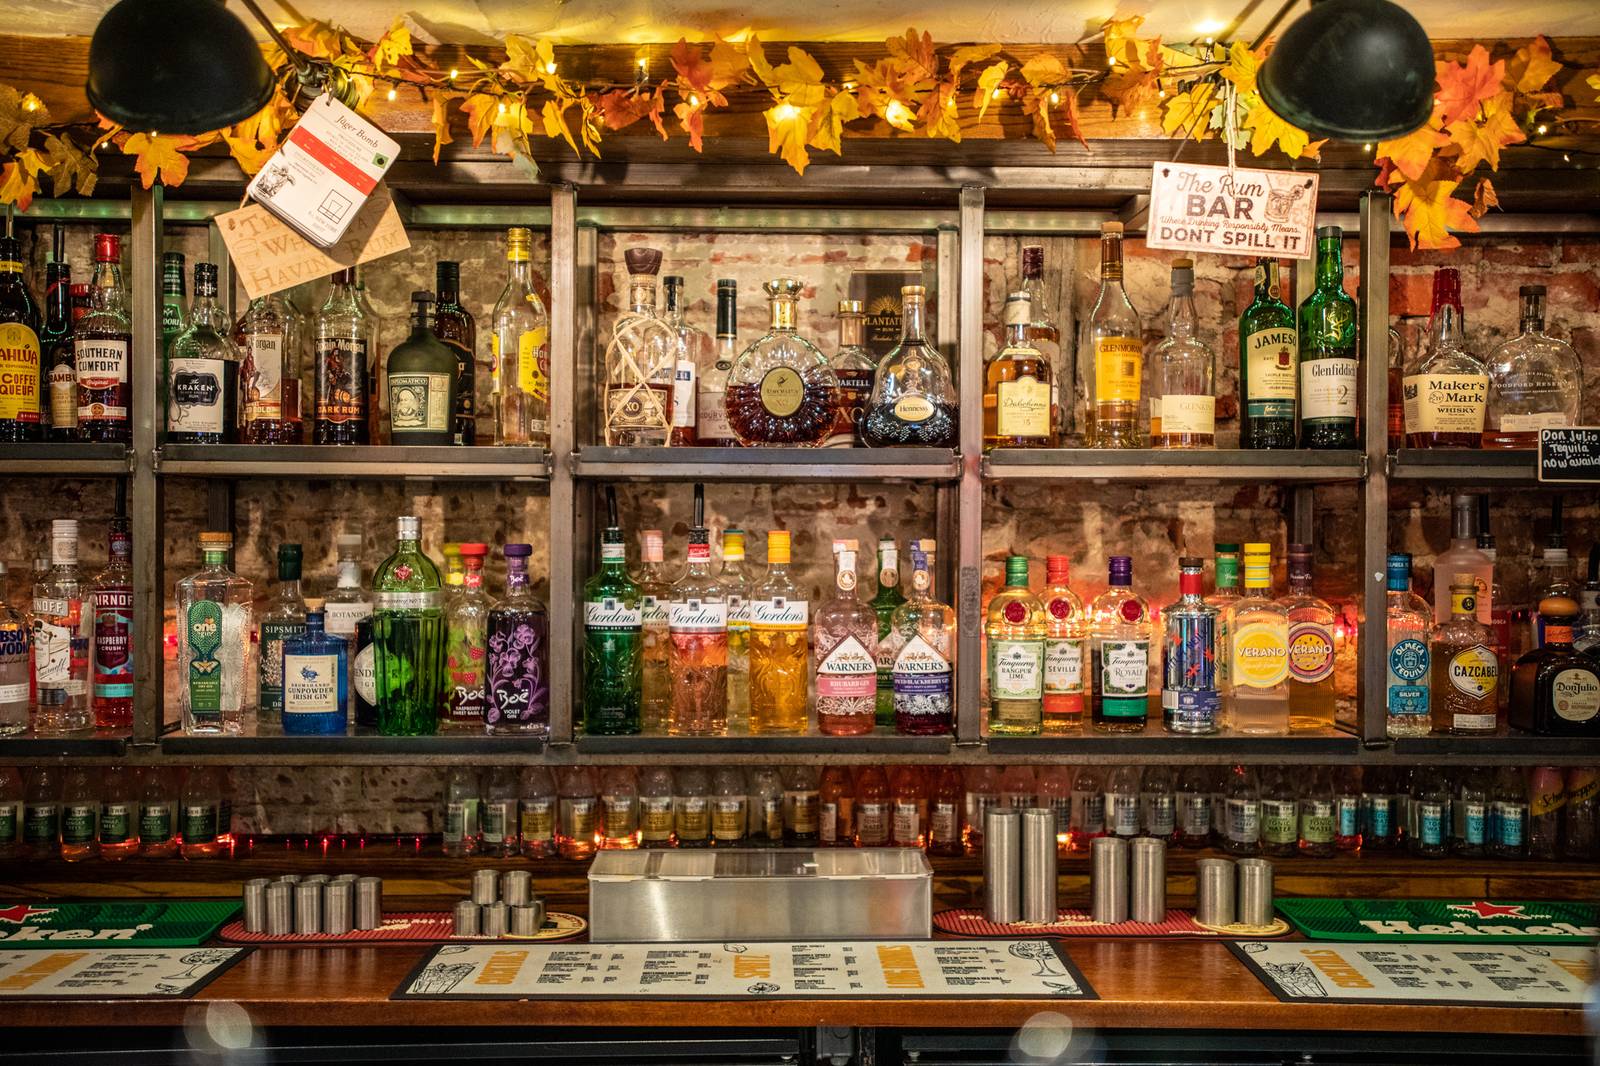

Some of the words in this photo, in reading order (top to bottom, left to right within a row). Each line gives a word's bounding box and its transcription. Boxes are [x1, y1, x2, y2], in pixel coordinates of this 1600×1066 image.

[356, 129, 379, 148] Bomb
[1177, 171, 1212, 193] The
[1186, 194, 1254, 220] BAR
[1222, 220, 1270, 233] Responsibly
[1222, 231, 1276, 248] SPILL
[1283, 236, 1302, 250] IT
[77, 348, 123, 361] SOUTHERN
[78, 361, 120, 372] COMFORT
[2, 373, 36, 386] COFFEE
[177, 384, 213, 392] KRAKEN
[1429, 380, 1485, 391] Maker's
[1446, 392, 1484, 403] Mark
[318, 406, 340, 414] DARK
[342, 406, 361, 414] RUM
[625, 401, 640, 411] XO
[1542, 430, 1566, 441] Don
[1570, 430, 1598, 442] Julio
[1550, 443, 1589, 459] Tequila
[1543, 459, 1568, 468] now
[587, 606, 636, 623] Gordon's
[671, 607, 721, 624] Gordon's
[753, 605, 804, 622] Gordon's
[193, 622, 217, 632] one
[1238, 647, 1287, 658] VERANO
[1287, 645, 1332, 656] VERANO
[1396, 643, 1425, 656] OLMECA
[998, 657, 1036, 668] Tanqueray
[1046, 654, 1080, 663] Tanqueray
[1111, 657, 1145, 666] Tanqueray
[826, 662, 873, 671] WARNER'S
[897, 662, 944, 671] WARNER'S
[1396, 664, 1426, 677] TEQUILA
[1454, 665, 1498, 677] CAZCABEL
[1556, 682, 1577, 692] Don
[496, 689, 529, 709] Boë
